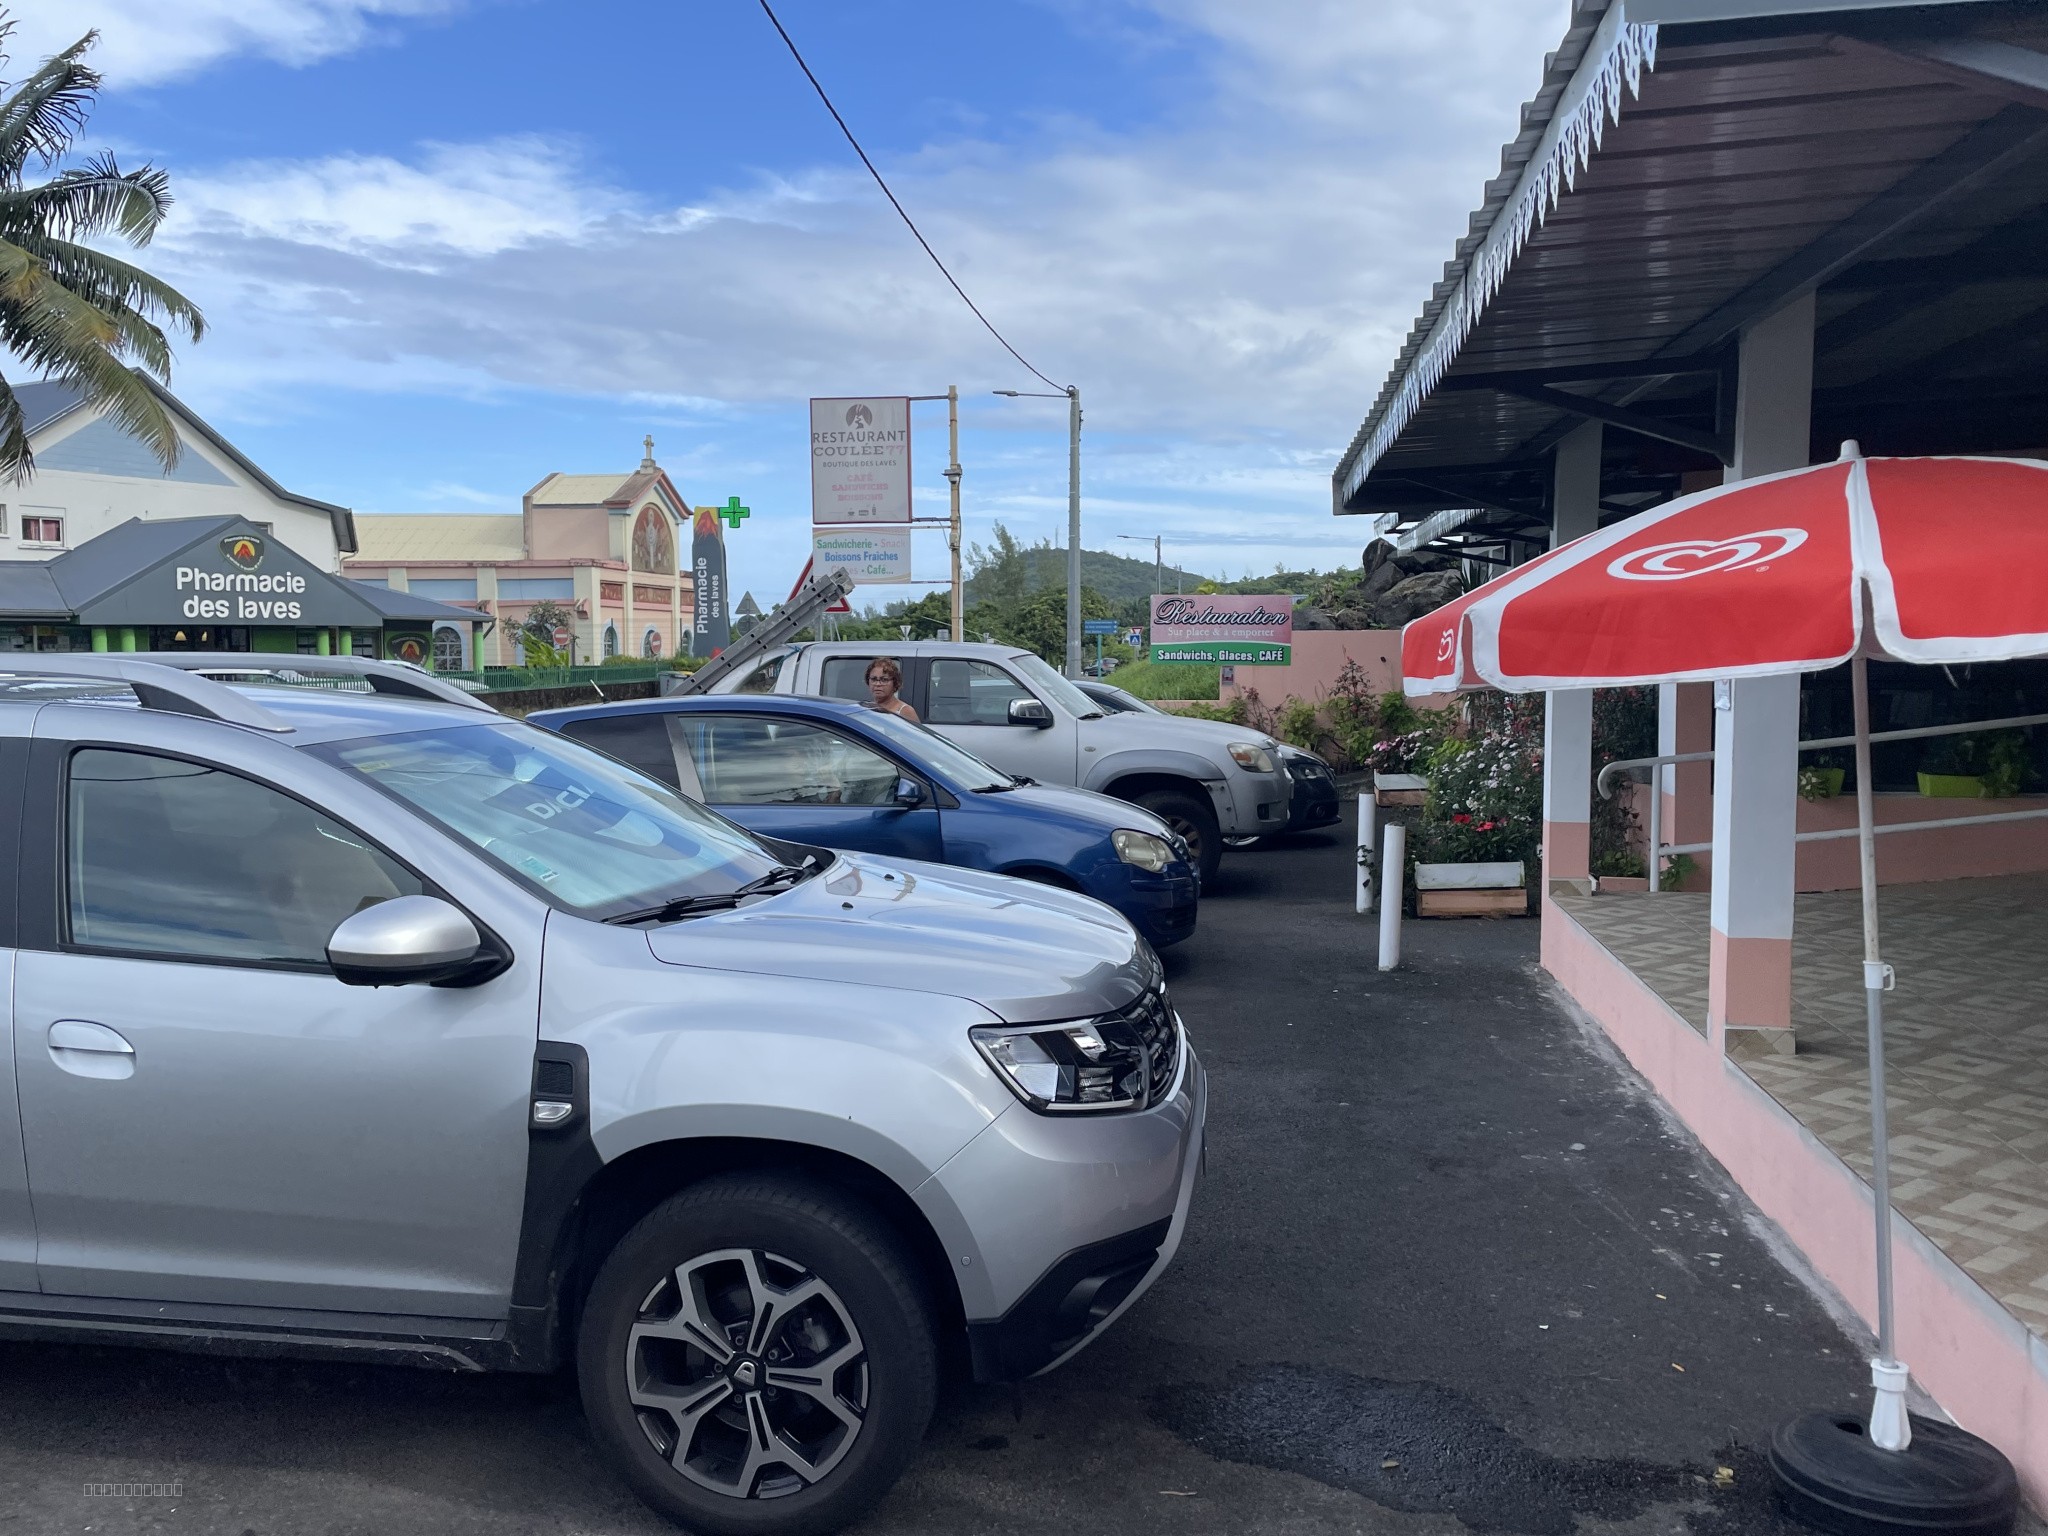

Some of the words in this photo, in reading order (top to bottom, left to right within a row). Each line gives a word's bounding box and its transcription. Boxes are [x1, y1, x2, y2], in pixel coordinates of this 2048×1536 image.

[813, 430, 906, 443] RESTAURANT
[822, 460, 858, 468] BOUTIQUE
[875, 459, 897, 467] LAVES
[816, 538, 873, 549] Sandwicherie
[824, 552, 862, 562] Boissons
[176, 567, 306, 594] Pharmacie
[711, 575, 719, 599] laves
[695, 557, 708, 633] Pharmacie
[183, 595, 230, 619] des
[238, 596, 301, 620] laves
[711, 601, 719, 618] des
[1153, 597, 1290, 626] Restauration
[1167, 626, 1184, 637] Sur
[1185, 626, 1210, 638] place
[1212, 627, 1221, 636] &
[1231, 628, 1275, 639] emporter
[1157, 649, 1217, 662] Sandwichs,
[1218, 649, 1256, 663] Glaces,
[1258, 648, 1284, 662] CAFÉ
